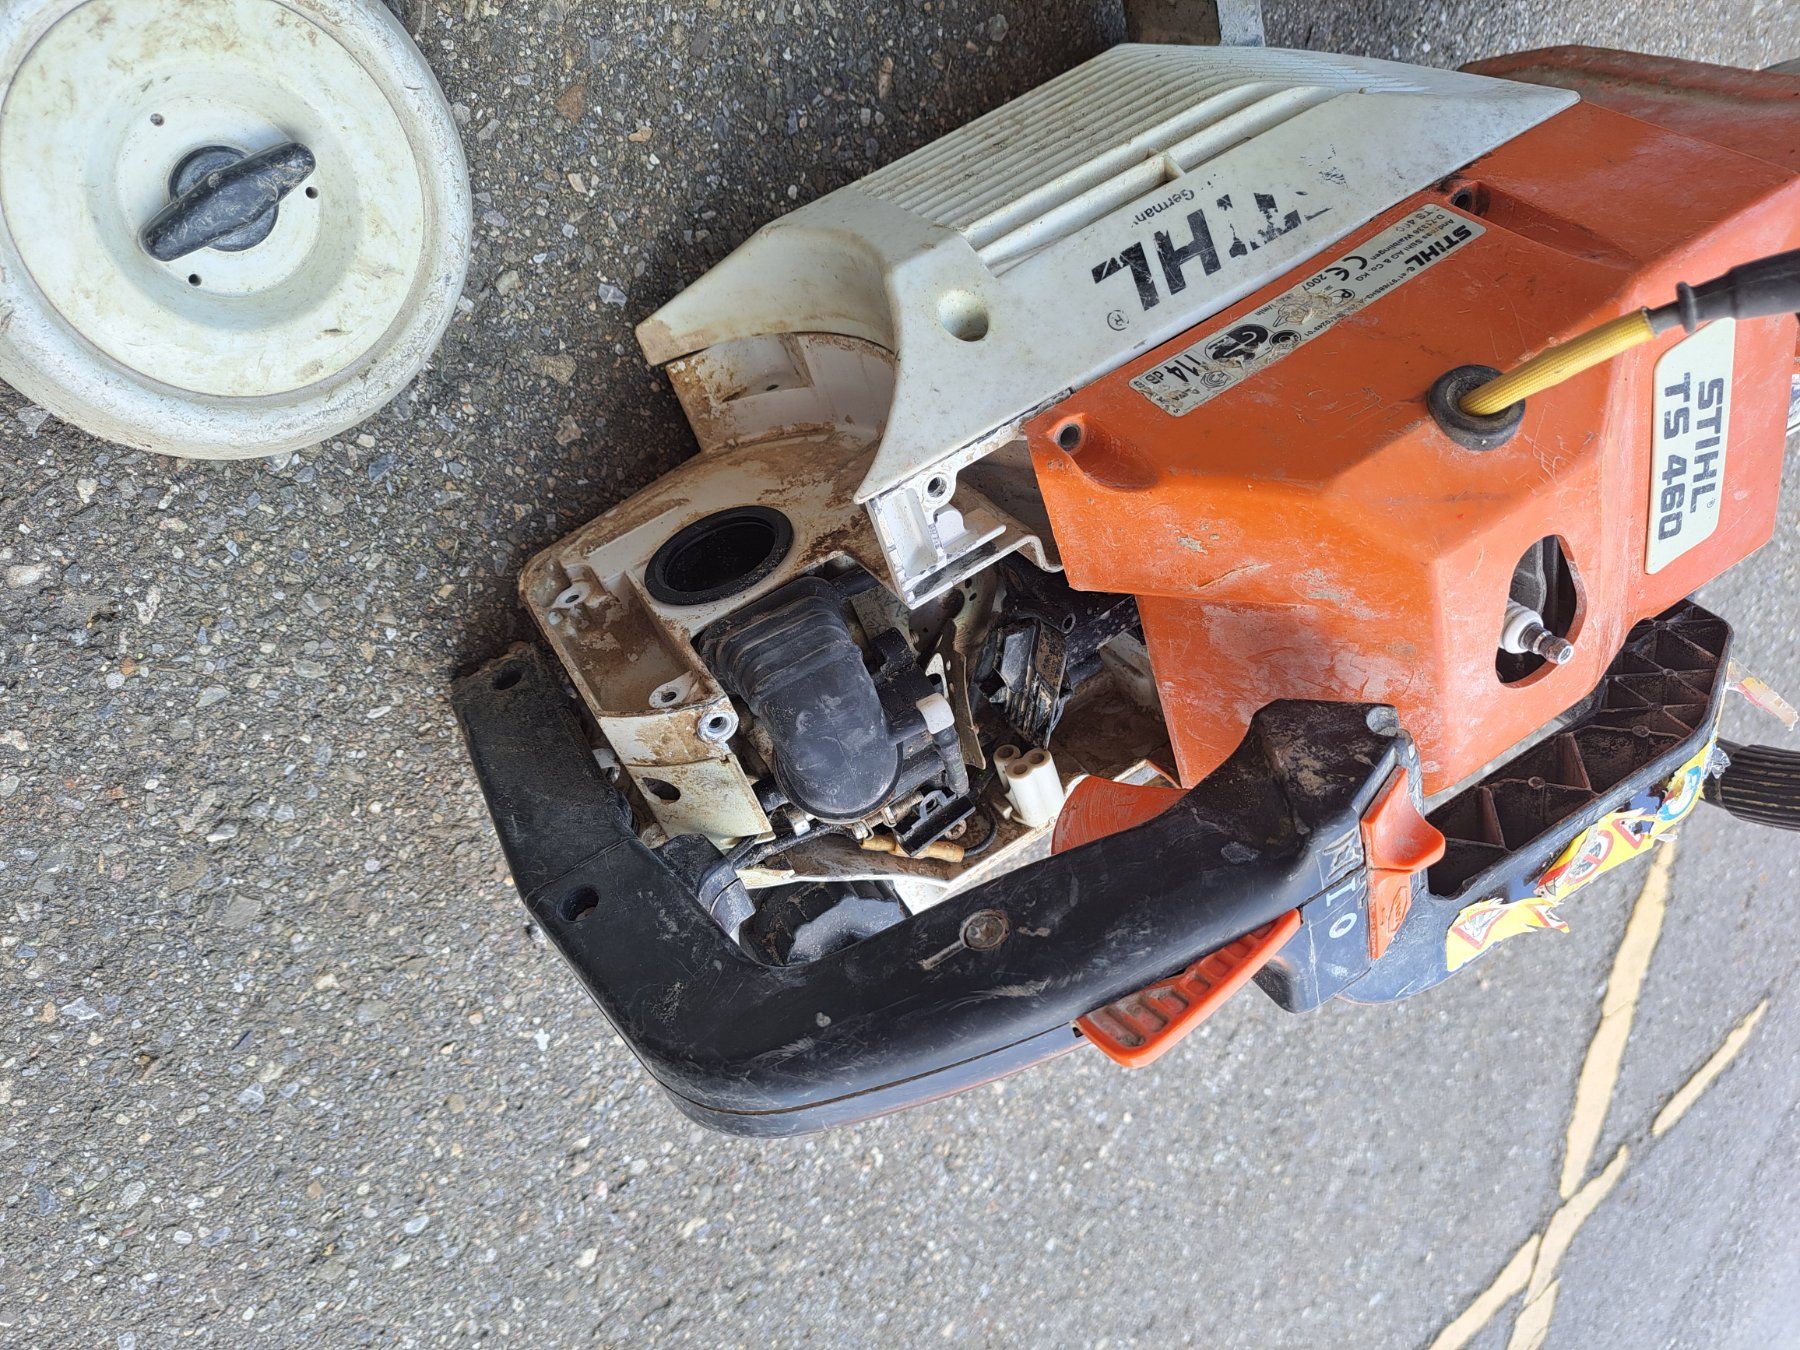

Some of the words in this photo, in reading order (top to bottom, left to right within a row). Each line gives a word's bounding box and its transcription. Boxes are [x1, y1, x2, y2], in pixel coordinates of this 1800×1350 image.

[1131, 188, 1195, 228] German
[1370, 233, 1414, 261] Waiblingen
[1391, 249, 1404, 260] AG
[1403, 238, 1424, 252] Stihl
[1302, 273, 1327, 291] 2007
[1355, 272, 1370, 282] KG
[1145, 370, 1165, 385] dB
[1164, 353, 1209, 383] 114
[1664, 372, 1691, 440] TS
[1658, 454, 1687, 541] 460
